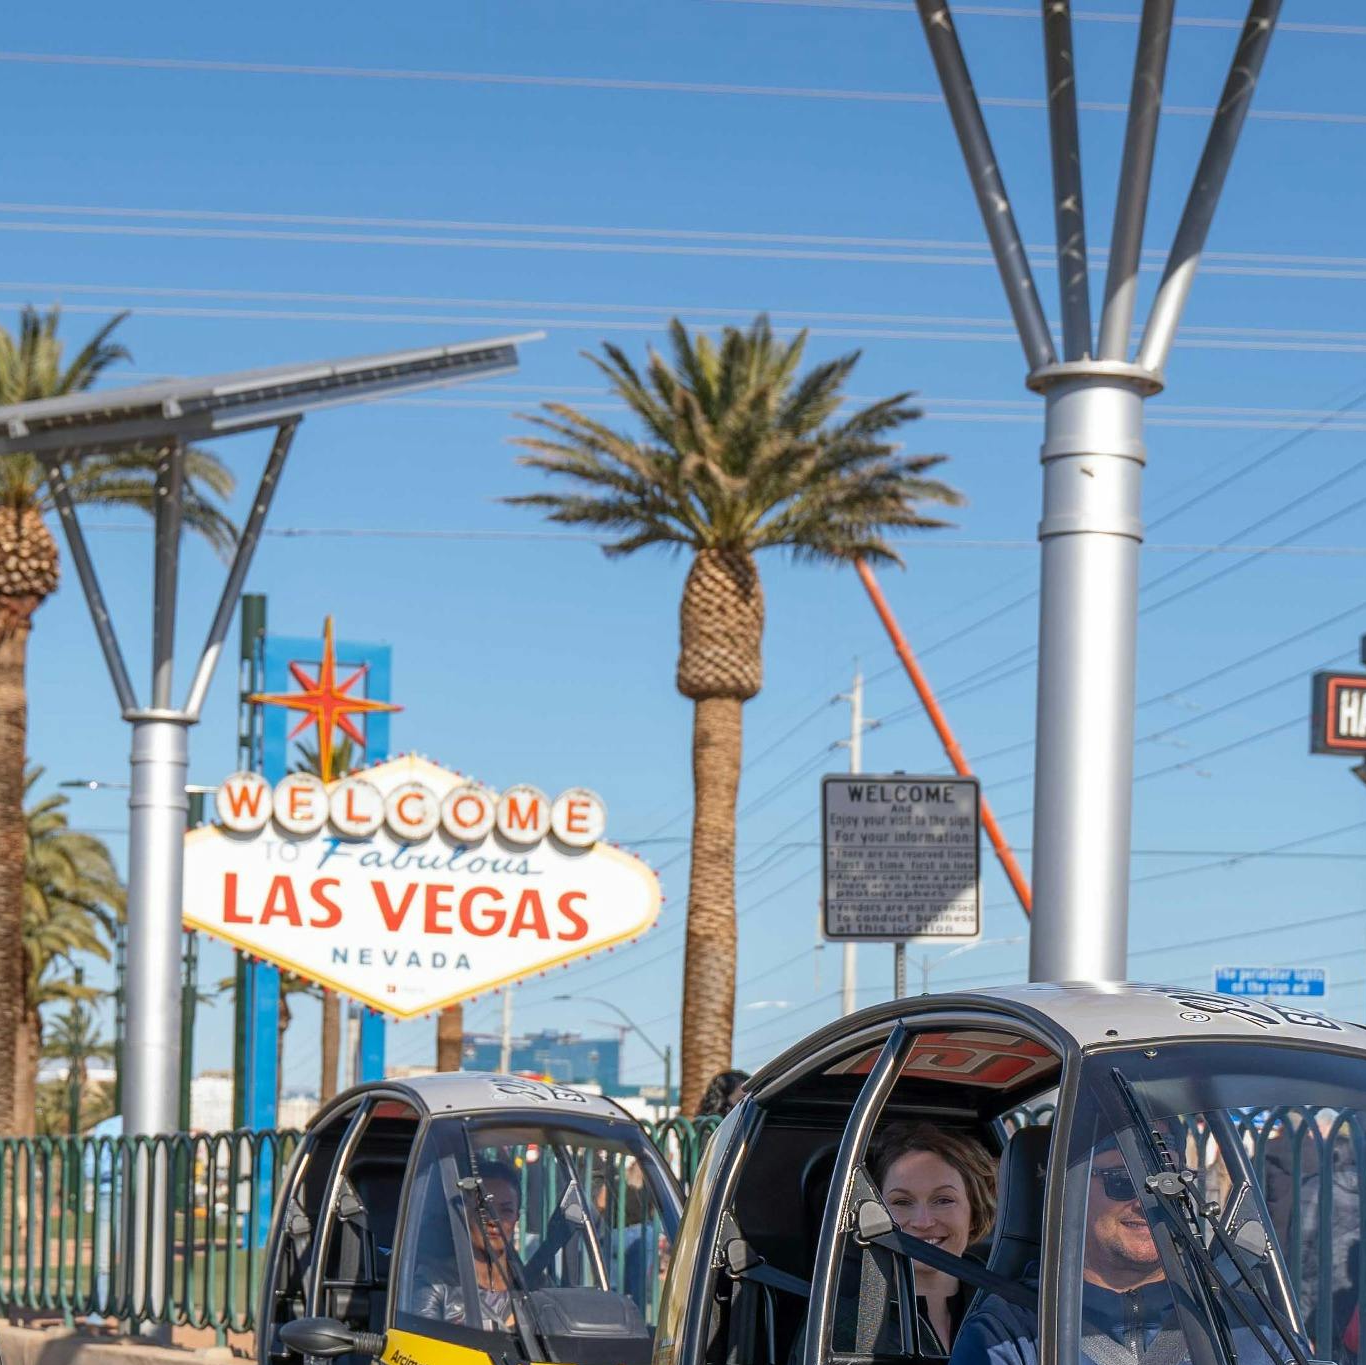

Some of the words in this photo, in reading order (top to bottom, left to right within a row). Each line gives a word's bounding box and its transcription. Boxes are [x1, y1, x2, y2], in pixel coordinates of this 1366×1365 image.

[848, 785, 955, 803] WELCOME
[225, 783, 590, 834] WELCOME
[891, 804, 912, 813] And
[830, 813, 858, 828] Enjoy
[863, 816, 885, 828] your
[891, 814, 911, 826] visit
[916, 815, 925, 826] to
[929, 814, 946, 826] the
[835, 830, 855, 842] For
[860, 832, 889, 844] your
[264, 839, 303, 864] TO
[317, 836, 545, 877] Fabulous
[223, 871, 342, 930] LAS
[371, 880, 590, 942] VEGAS
[856, 912, 910, 922] conduct
[915, 912, 974, 923] business
[858, 922, 886, 932] this
[332, 946, 472, 970] NEVADA
